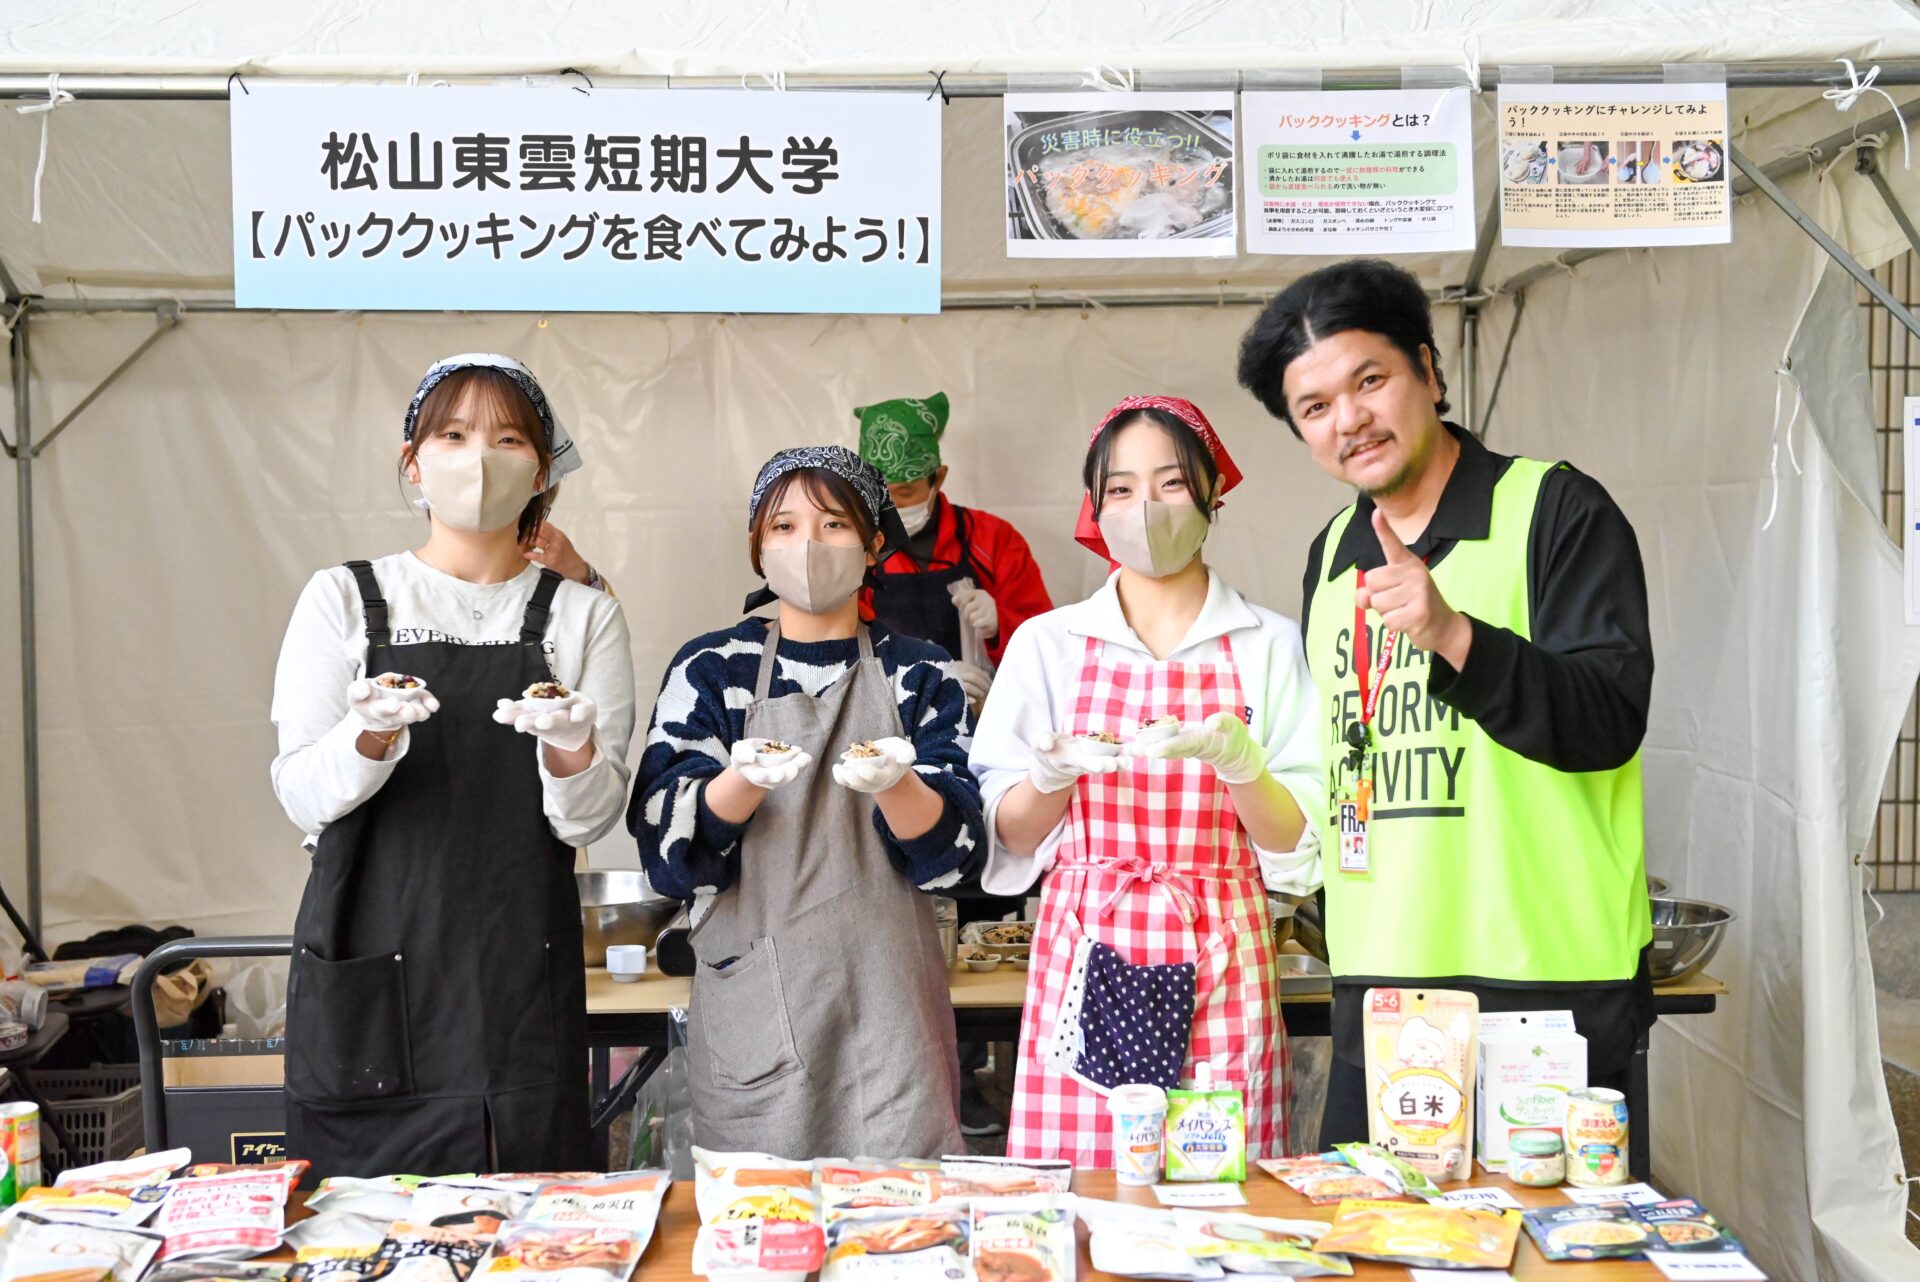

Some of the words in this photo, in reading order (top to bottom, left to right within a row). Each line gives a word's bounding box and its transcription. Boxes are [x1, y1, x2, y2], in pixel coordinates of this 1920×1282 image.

[1507, 104, 1708, 118] パッククッキングにチャレンジしてみよ
[320, 130, 841, 195] 松山東雲短期大学
[1014, 161, 1228, 189] パッククッキング
[250, 208, 930, 266] 【パッククッキングを食べてみよう!】
[1399, 1090, 1444, 1118] 白米
[1176, 1119, 1232, 1131] メイバランス
[242, 1143, 285, 1156] アイケー
